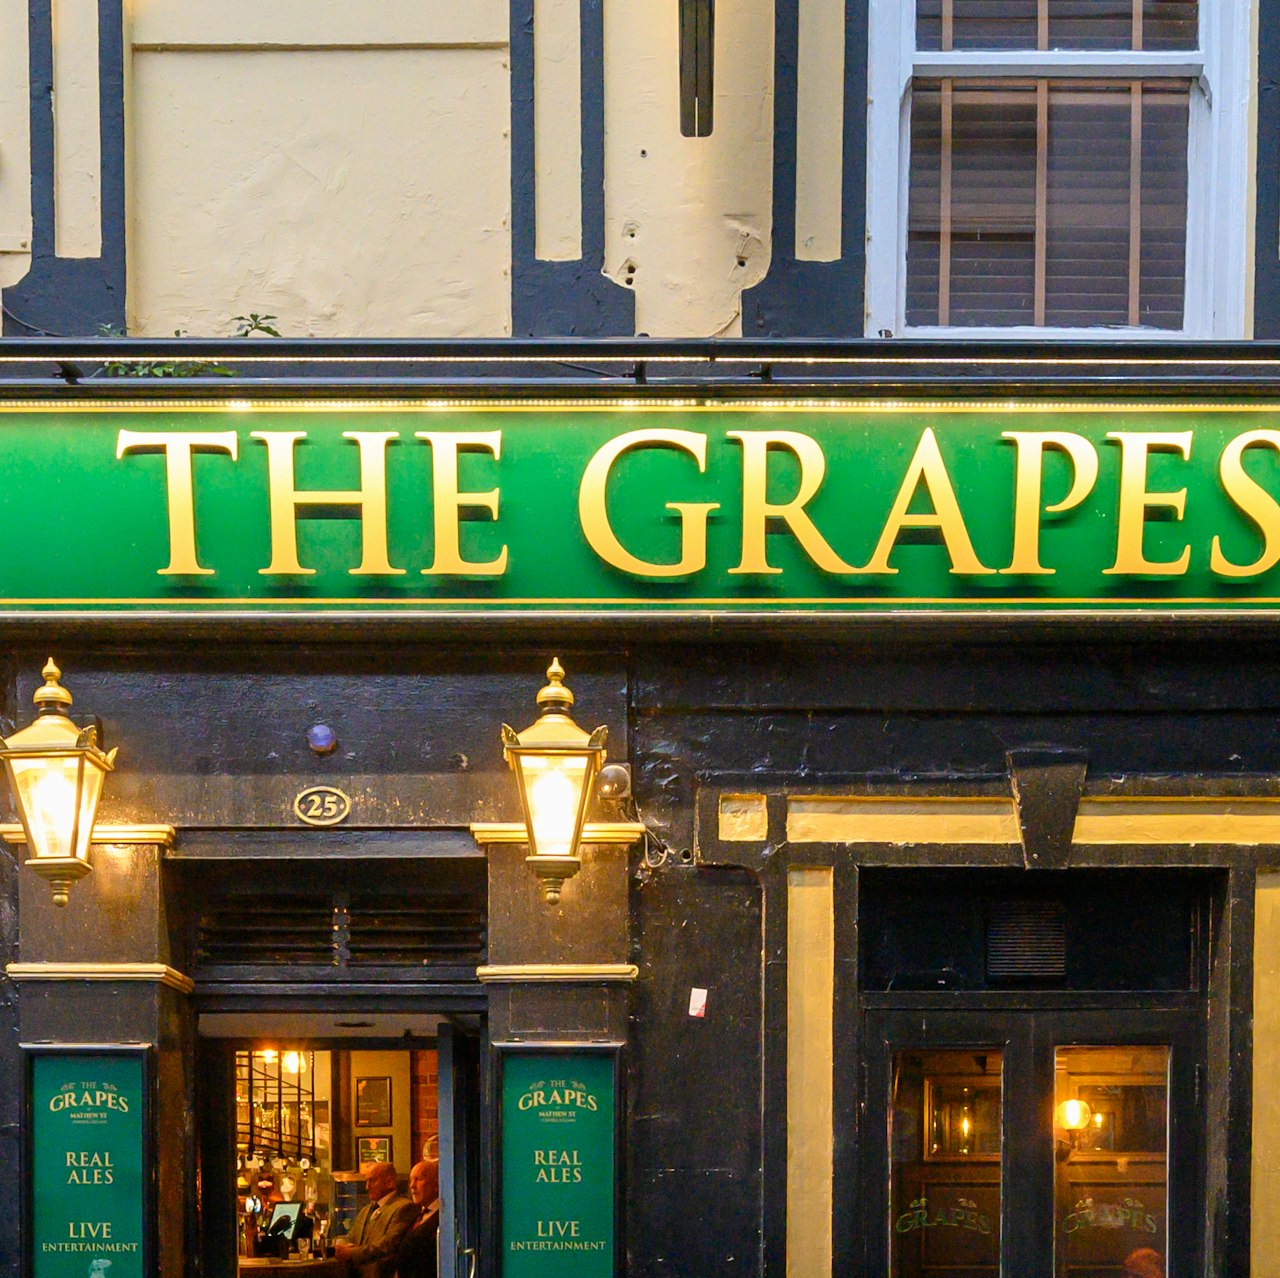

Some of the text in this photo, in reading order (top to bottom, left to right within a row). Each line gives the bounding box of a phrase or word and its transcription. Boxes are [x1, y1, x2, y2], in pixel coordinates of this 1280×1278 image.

[116, 428, 508, 575] THE
[307, 794, 337, 817] 25
[80, 1081, 97, 1089] THE
[550, 1080, 567, 1088] THE
[49, 1090, 129, 1113] GRAPES
[518, 1089, 598, 1112] GRAPES
[65, 1152, 114, 1167] REAL
[534, 1150, 582, 1166] REAL
[66, 1169, 114, 1185] ALES
[535, 1168, 582, 1183] ALES
[536, 1221, 581, 1237] LIVE
[896, 1209, 991, 1235] GRAPES
[68, 1222, 112, 1239] LIVE
[42, 1243, 139, 1253] ENTERTAINMENT
[510, 1241, 606, 1251] ENTERTAINMENT
